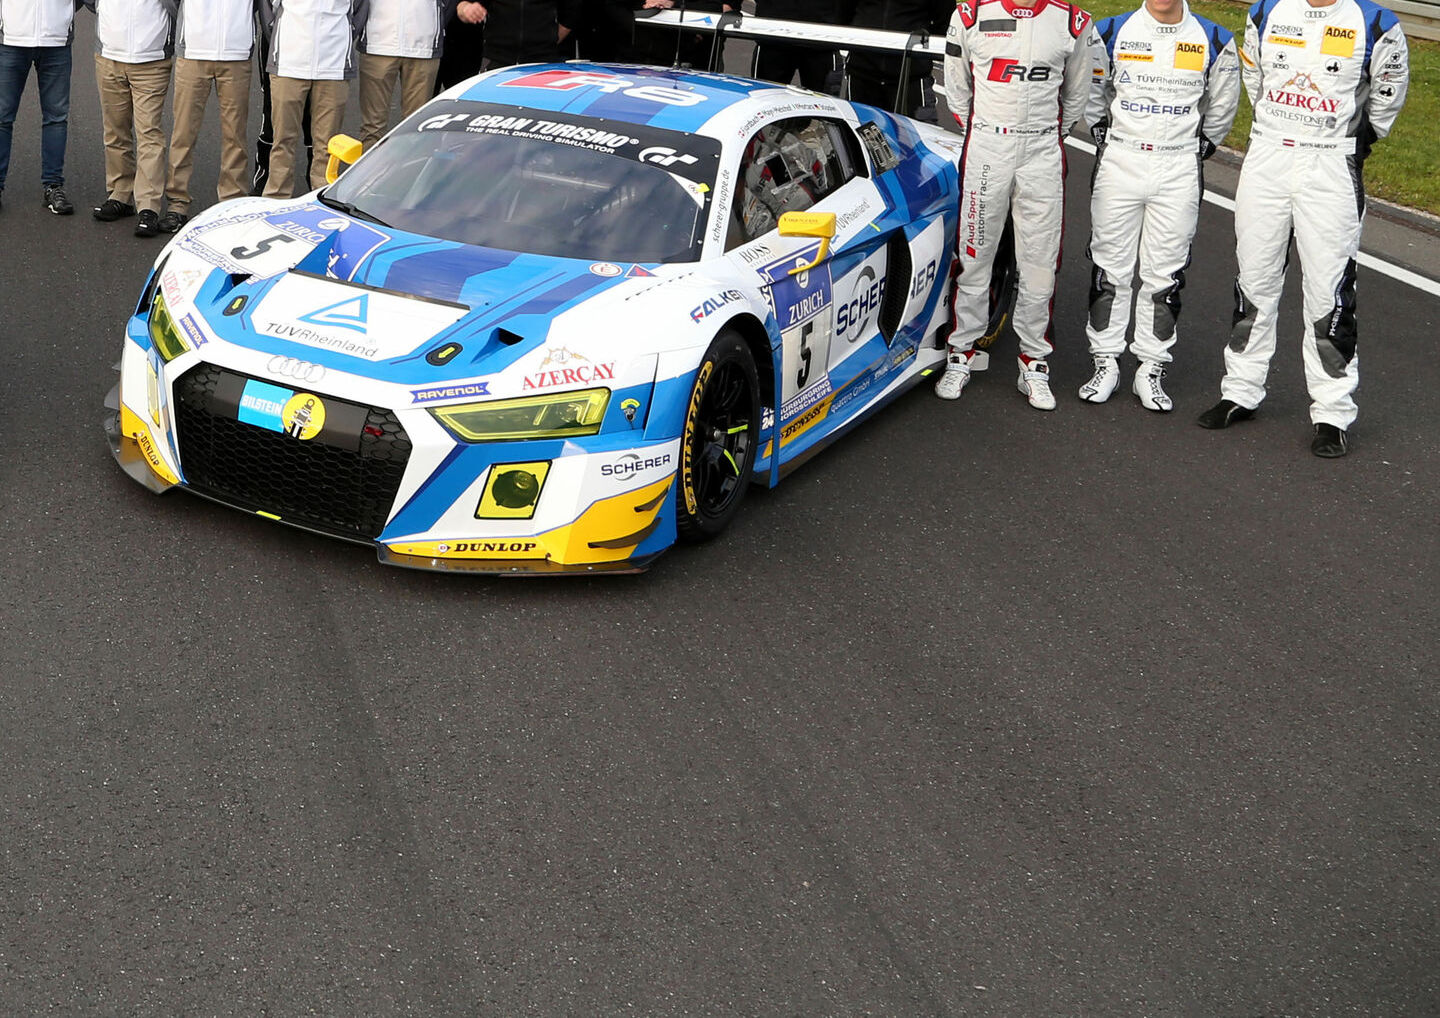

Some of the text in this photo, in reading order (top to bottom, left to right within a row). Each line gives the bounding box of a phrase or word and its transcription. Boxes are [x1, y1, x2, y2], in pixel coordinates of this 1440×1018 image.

[1325, 27, 1356, 40] ADAC
[1176, 43, 1205, 54] ADAC
[1001, 63, 1051, 82] R8
[540, 74, 709, 107] R8
[1266, 89, 1340, 113] AZERÇAY
[1120, 100, 1191, 115] SCHERER
[1265, 106, 1324, 126] CASTLESTONE
[469, 114, 532, 131] GRAN
[484, 128, 511, 136] REAL
[512, 130, 554, 142] DRIVING
[554, 136, 615, 155] SIMULATOR
[712, 168, 731, 244] scherer-gruppe.de
[967, 190, 977, 245] Audi Sport
[978, 164, 991, 246] customer racing
[230, 233, 296, 260] 5
[739, 243, 772, 264] BOSS
[162, 270, 185, 308] AZERÇAY
[690, 288, 747, 324] FALKEN
[788, 289, 824, 325] ZURICH
[182, 315, 204, 348] RAVENOL
[797, 320, 814, 390] 5
[521, 362, 616, 391] AZERÇAY
[241, 394, 283, 416] BILSTEIN
[416, 385, 485, 401] RAVENOL
[685, 368, 709, 487] DUNLOP
[140, 436, 160, 466] DUNLOP
[600, 453, 672, 477] SCHERER
[454, 542, 537, 552] DUNLOP
